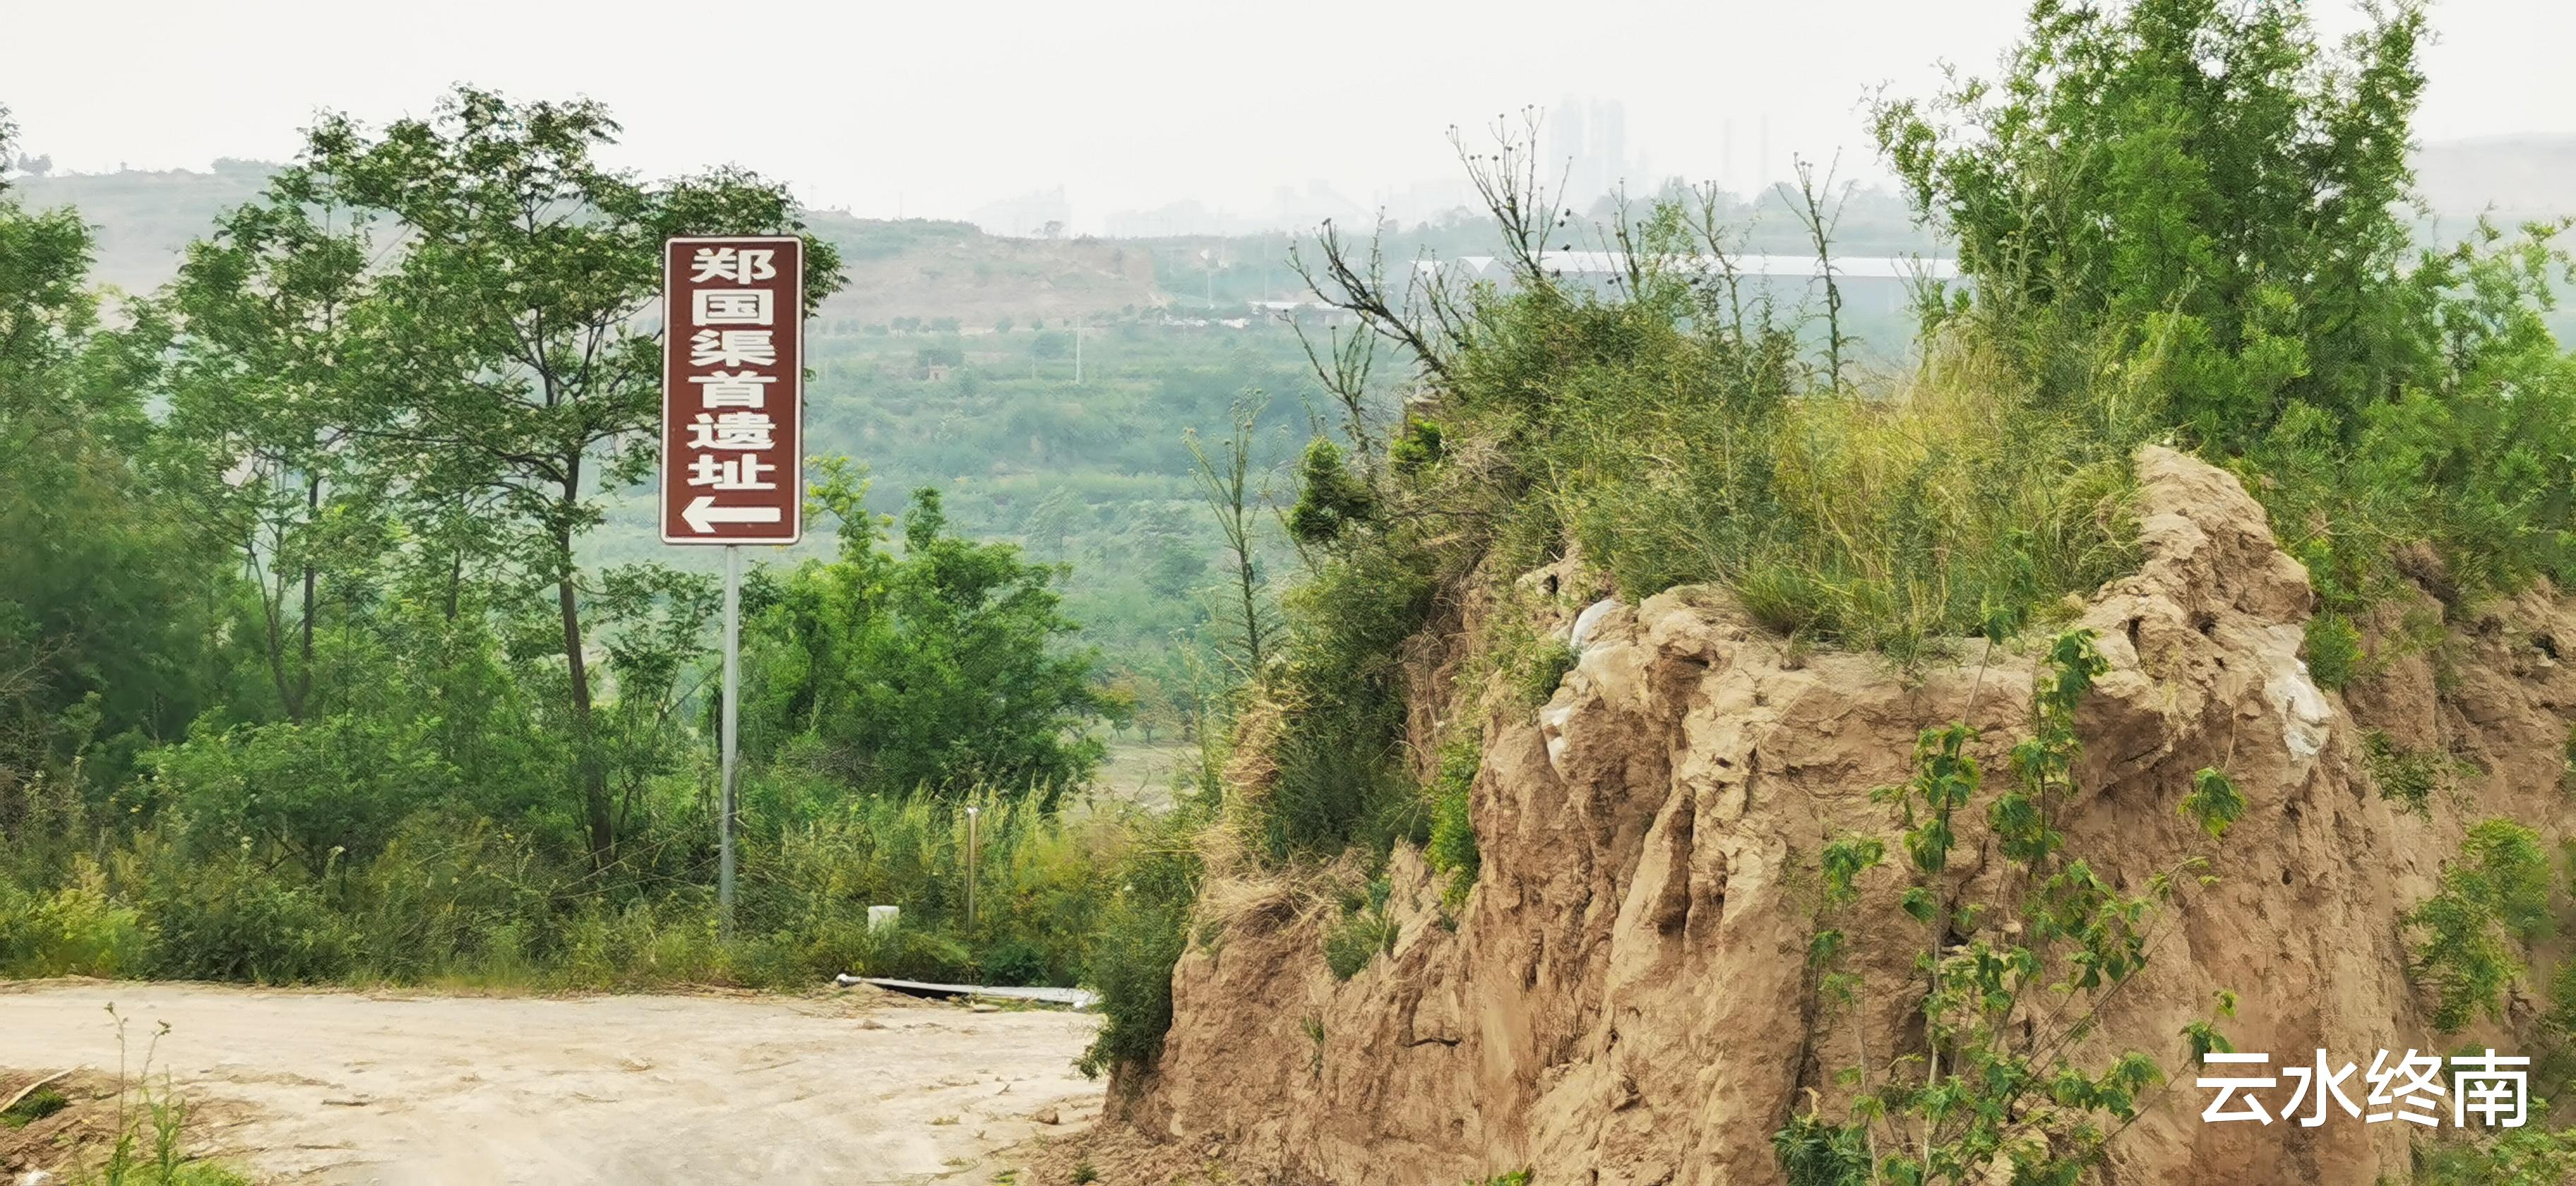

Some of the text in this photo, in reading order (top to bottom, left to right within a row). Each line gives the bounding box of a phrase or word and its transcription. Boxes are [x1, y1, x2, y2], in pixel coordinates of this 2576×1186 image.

[687, 247, 777, 490] 郑国渠首遗址
